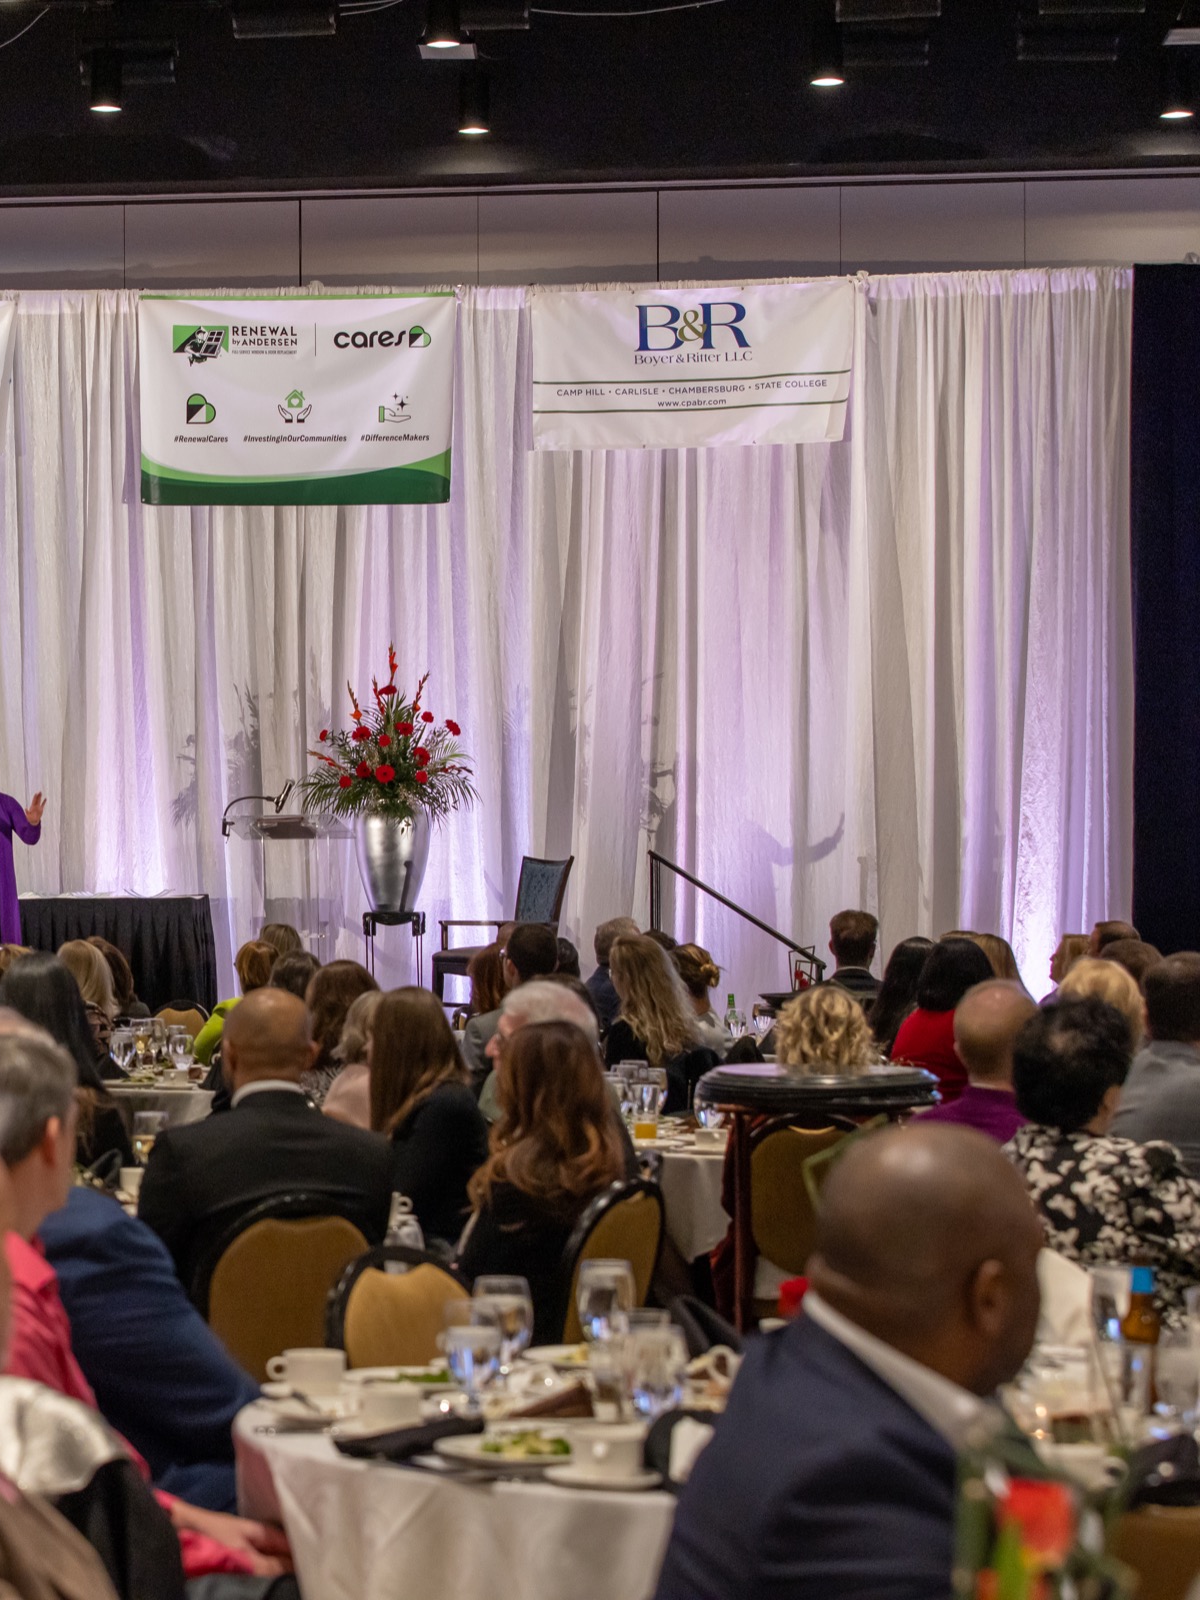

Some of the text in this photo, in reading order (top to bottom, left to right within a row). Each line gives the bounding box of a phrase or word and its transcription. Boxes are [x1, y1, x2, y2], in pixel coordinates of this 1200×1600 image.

[232, 326, 298, 336] RENEWAL
[634, 302, 752, 352] B&R
[232, 338, 298, 346] by ANDERSEN
[334, 330, 406, 349] cares
[634, 351, 753, 366] Boyer & Ritter LLC
[669, 385, 745, 394] CHAMBERSBURG
[755, 381, 782, 390] STATE
[784, 379, 828, 388] COLLEGE
[657, 399, 727, 407] www.cpabr.com
[174, 435, 228, 443] #RenewalCares
[243, 434, 347, 444] #InvestingInOurCommunities
[360, 433, 430, 442] #DifferenceMakers
